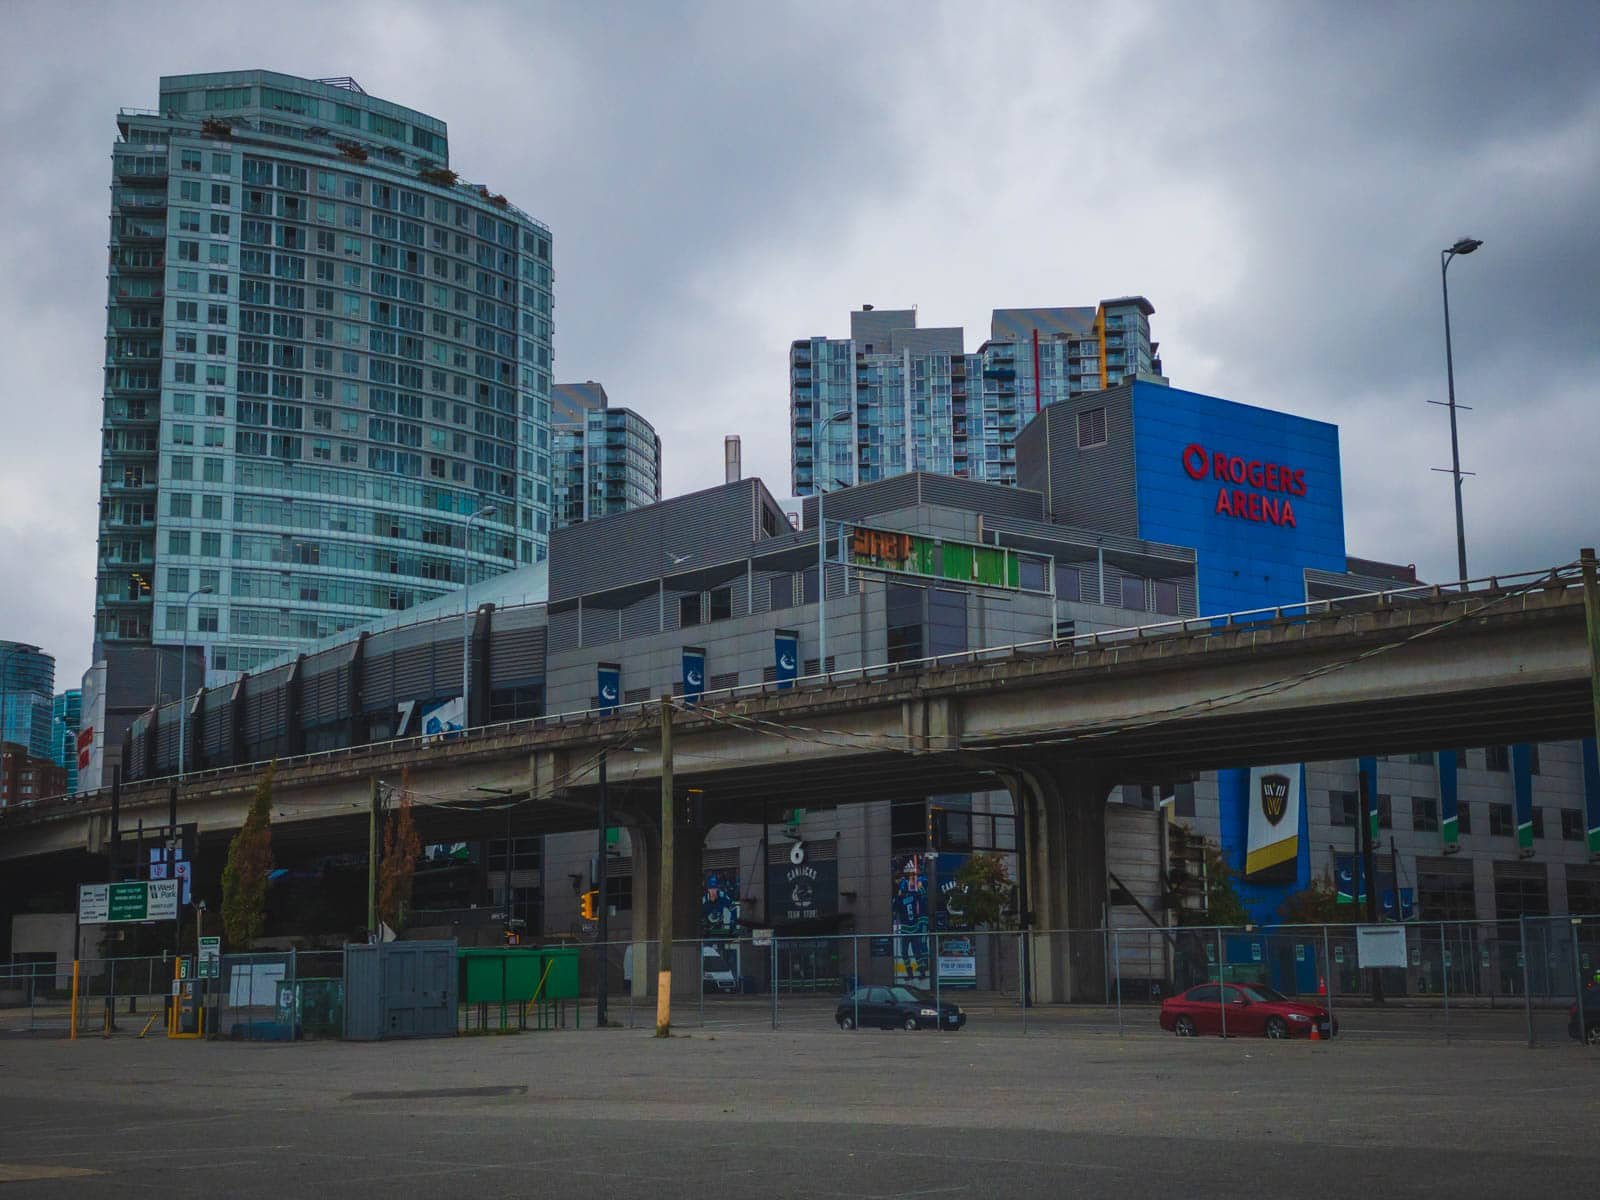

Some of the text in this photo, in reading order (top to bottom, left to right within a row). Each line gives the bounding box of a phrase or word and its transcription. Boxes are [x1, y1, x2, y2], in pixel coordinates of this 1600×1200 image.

[1213, 453, 1306, 496] ROGERS
[1216, 488, 1296, 527] ARENA
[396, 700, 416, 736] 7
[790, 841, 805, 865] 6
[786, 866, 818, 881] CANUCKS
